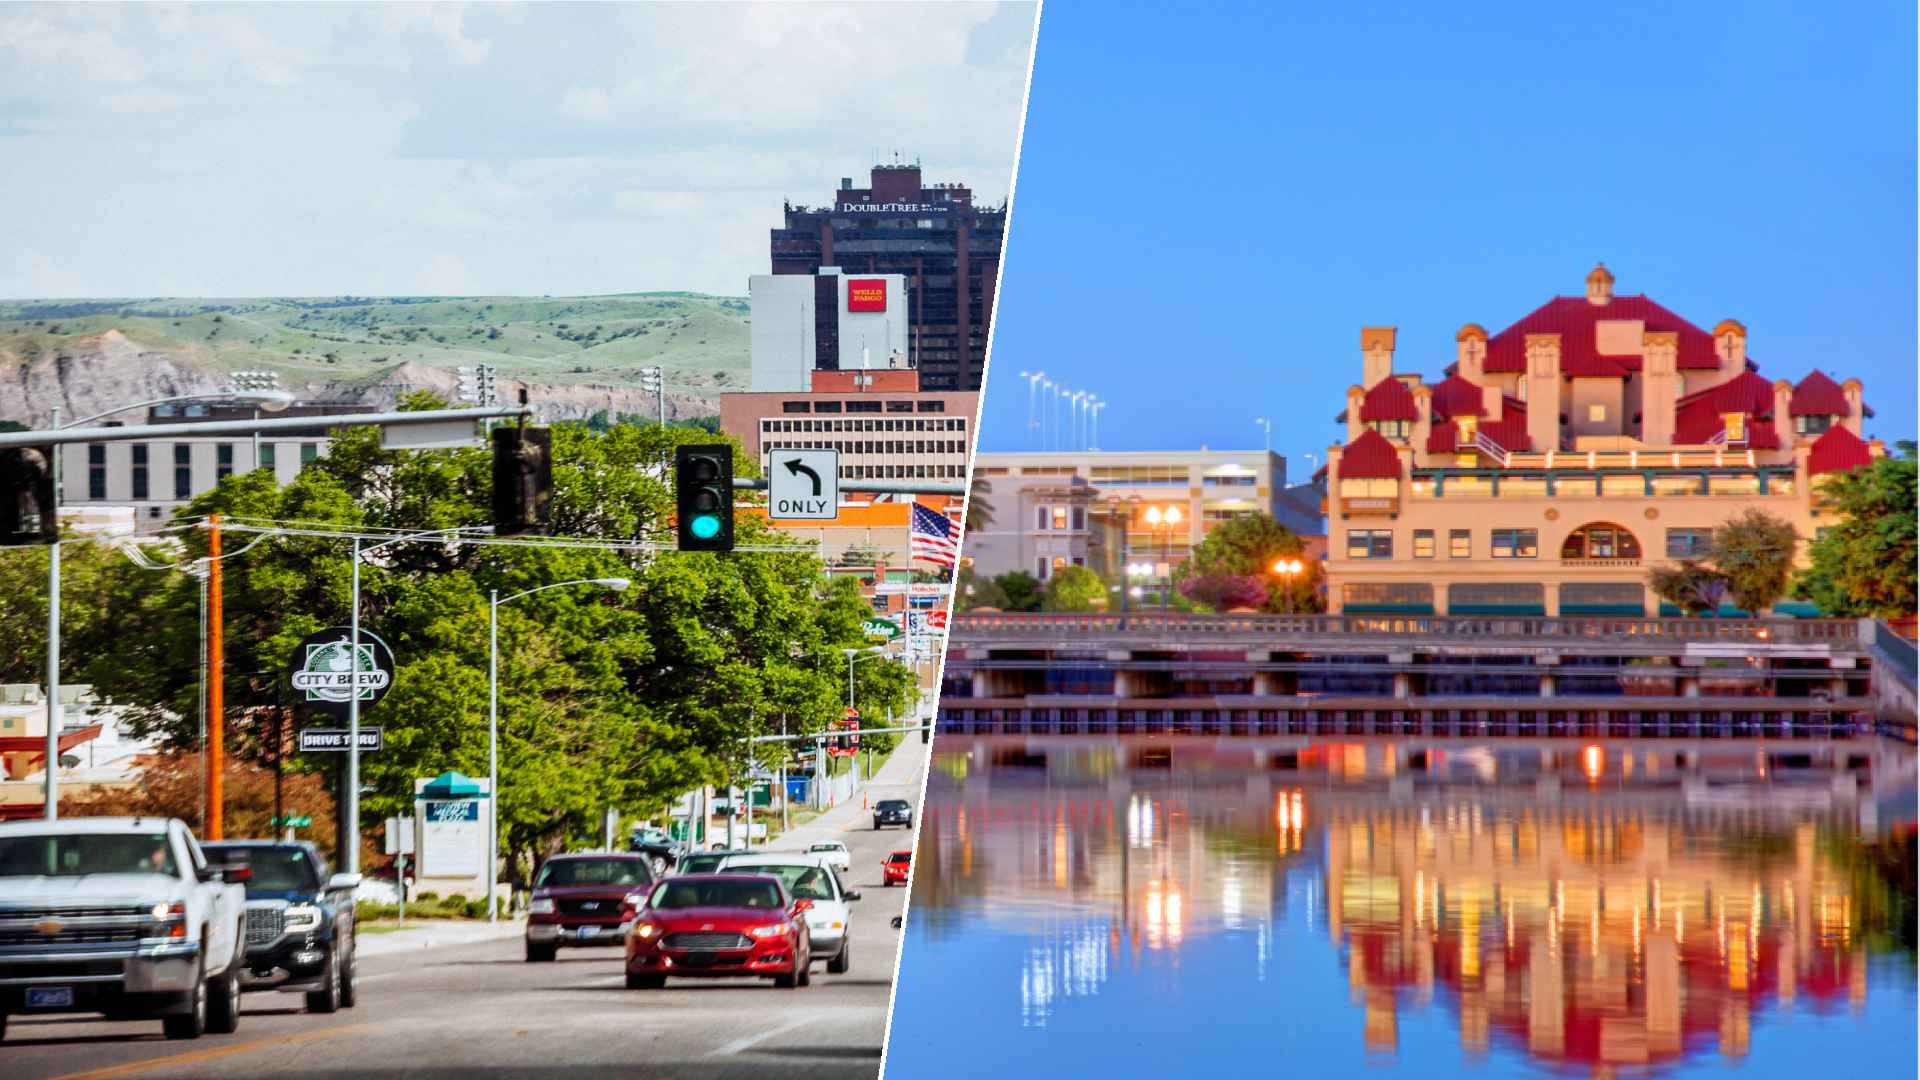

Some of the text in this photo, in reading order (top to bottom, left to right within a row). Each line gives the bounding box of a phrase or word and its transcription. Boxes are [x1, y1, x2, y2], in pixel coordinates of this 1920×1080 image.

[778, 499, 828, 514] ONLY
[296, 674, 332, 685] CITY
[303, 734, 377, 746] DRIVE TRU
